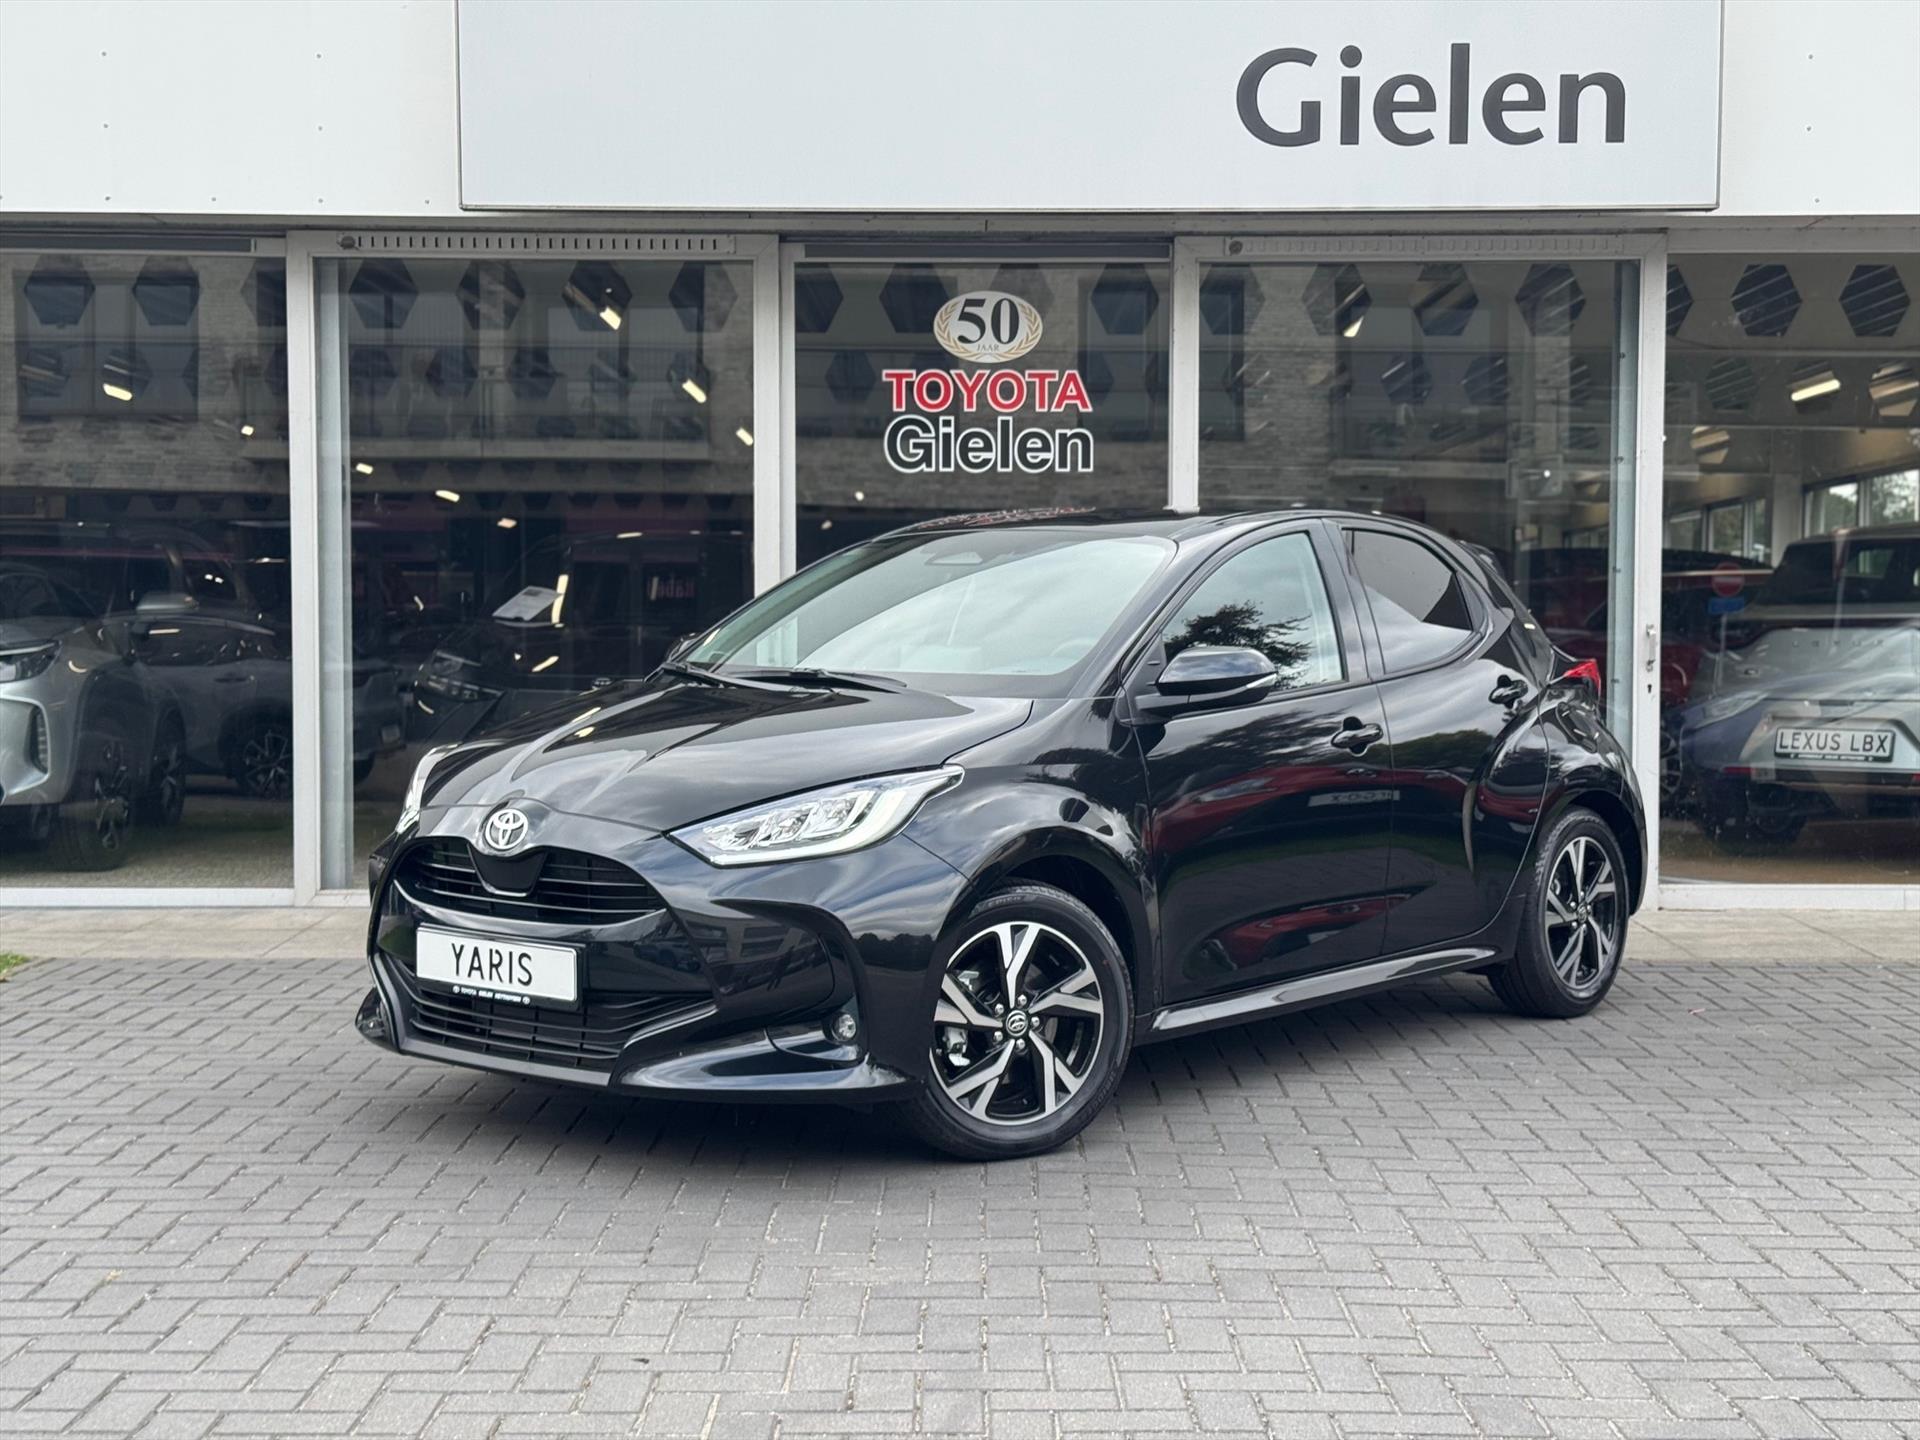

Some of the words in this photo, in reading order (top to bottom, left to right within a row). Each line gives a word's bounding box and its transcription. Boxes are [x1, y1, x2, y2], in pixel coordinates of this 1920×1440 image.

[1236, 42, 1626, 147] Gielen
[957, 297, 1020, 345] 50
[976, 343, 1001, 352] JAAR
[882, 369, 1093, 412] TOYOTA
[884, 414, 1094, 473] Gielen
[1779, 731, 1841, 751] LEXUS
[1849, 734, 1889, 753] LBX
[451, 943, 532, 986] YARIS
